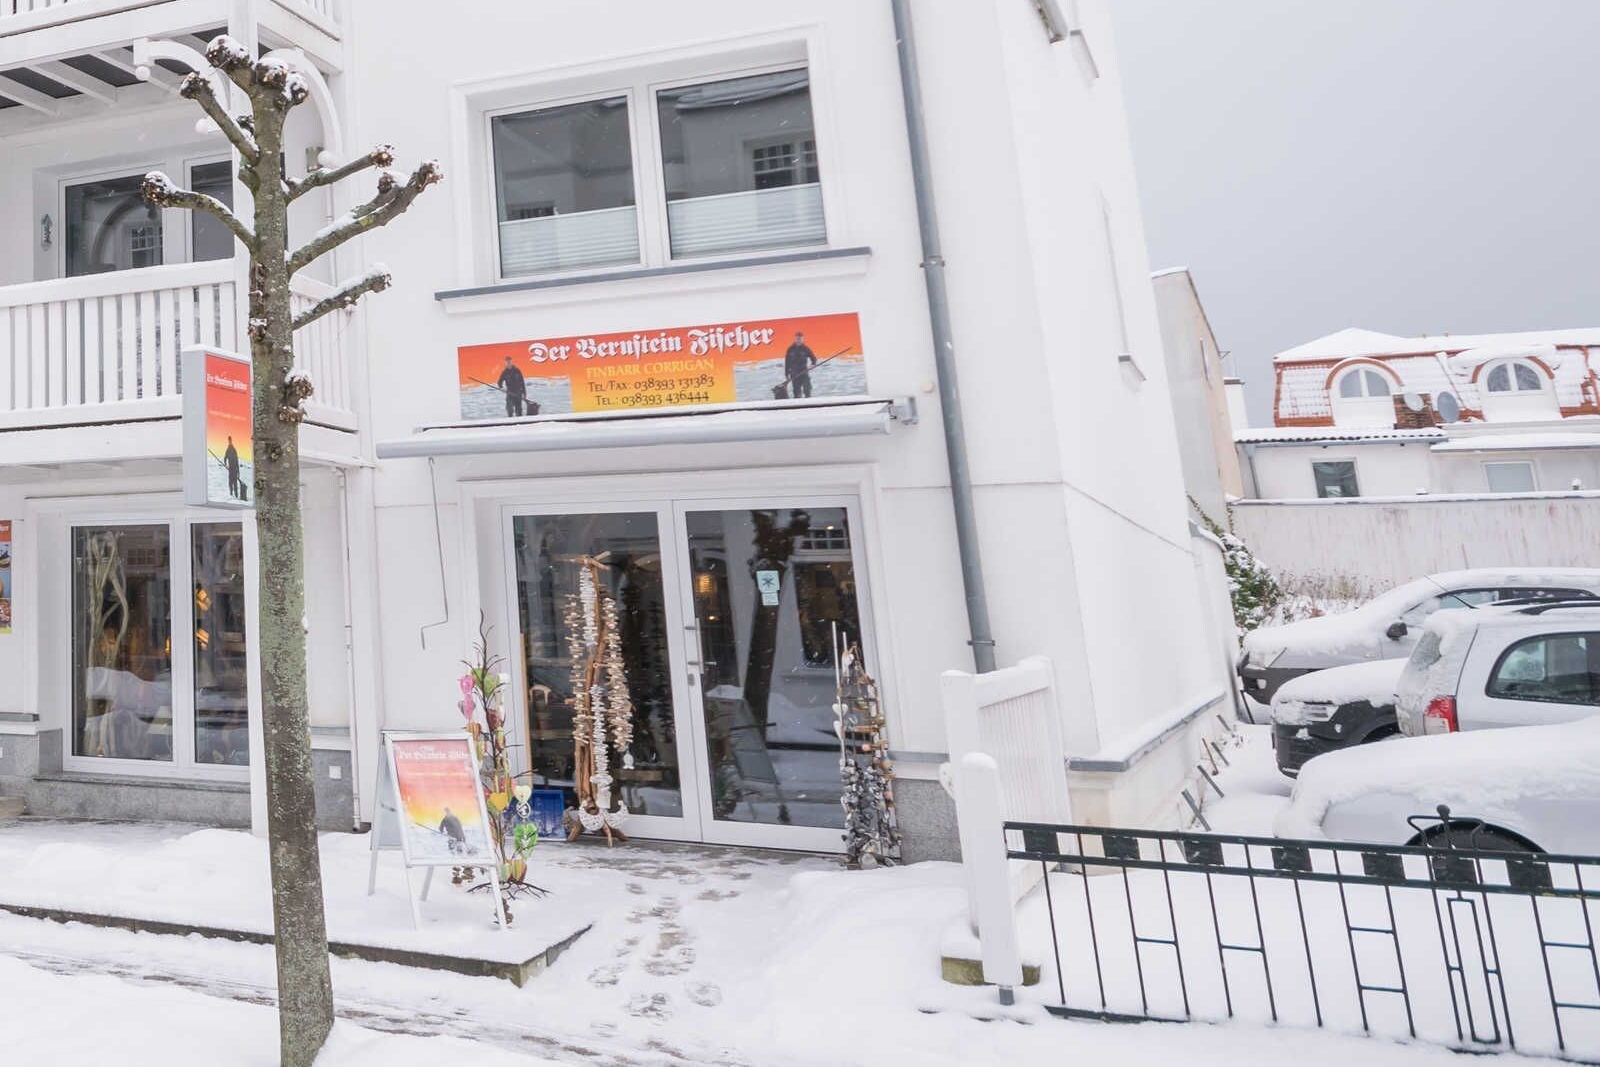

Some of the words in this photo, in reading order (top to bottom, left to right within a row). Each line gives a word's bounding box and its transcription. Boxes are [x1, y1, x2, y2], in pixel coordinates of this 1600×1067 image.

[528, 342, 571, 363] Der
[586, 363, 642, 379] FINBARR
[644, 358, 715, 376] CORRIGAN
[633, 377, 675, 392] 038393
[678, 374, 715, 389] 131383
[621, 392, 662, 406] 038393
[665, 390, 710, 403] 436444
